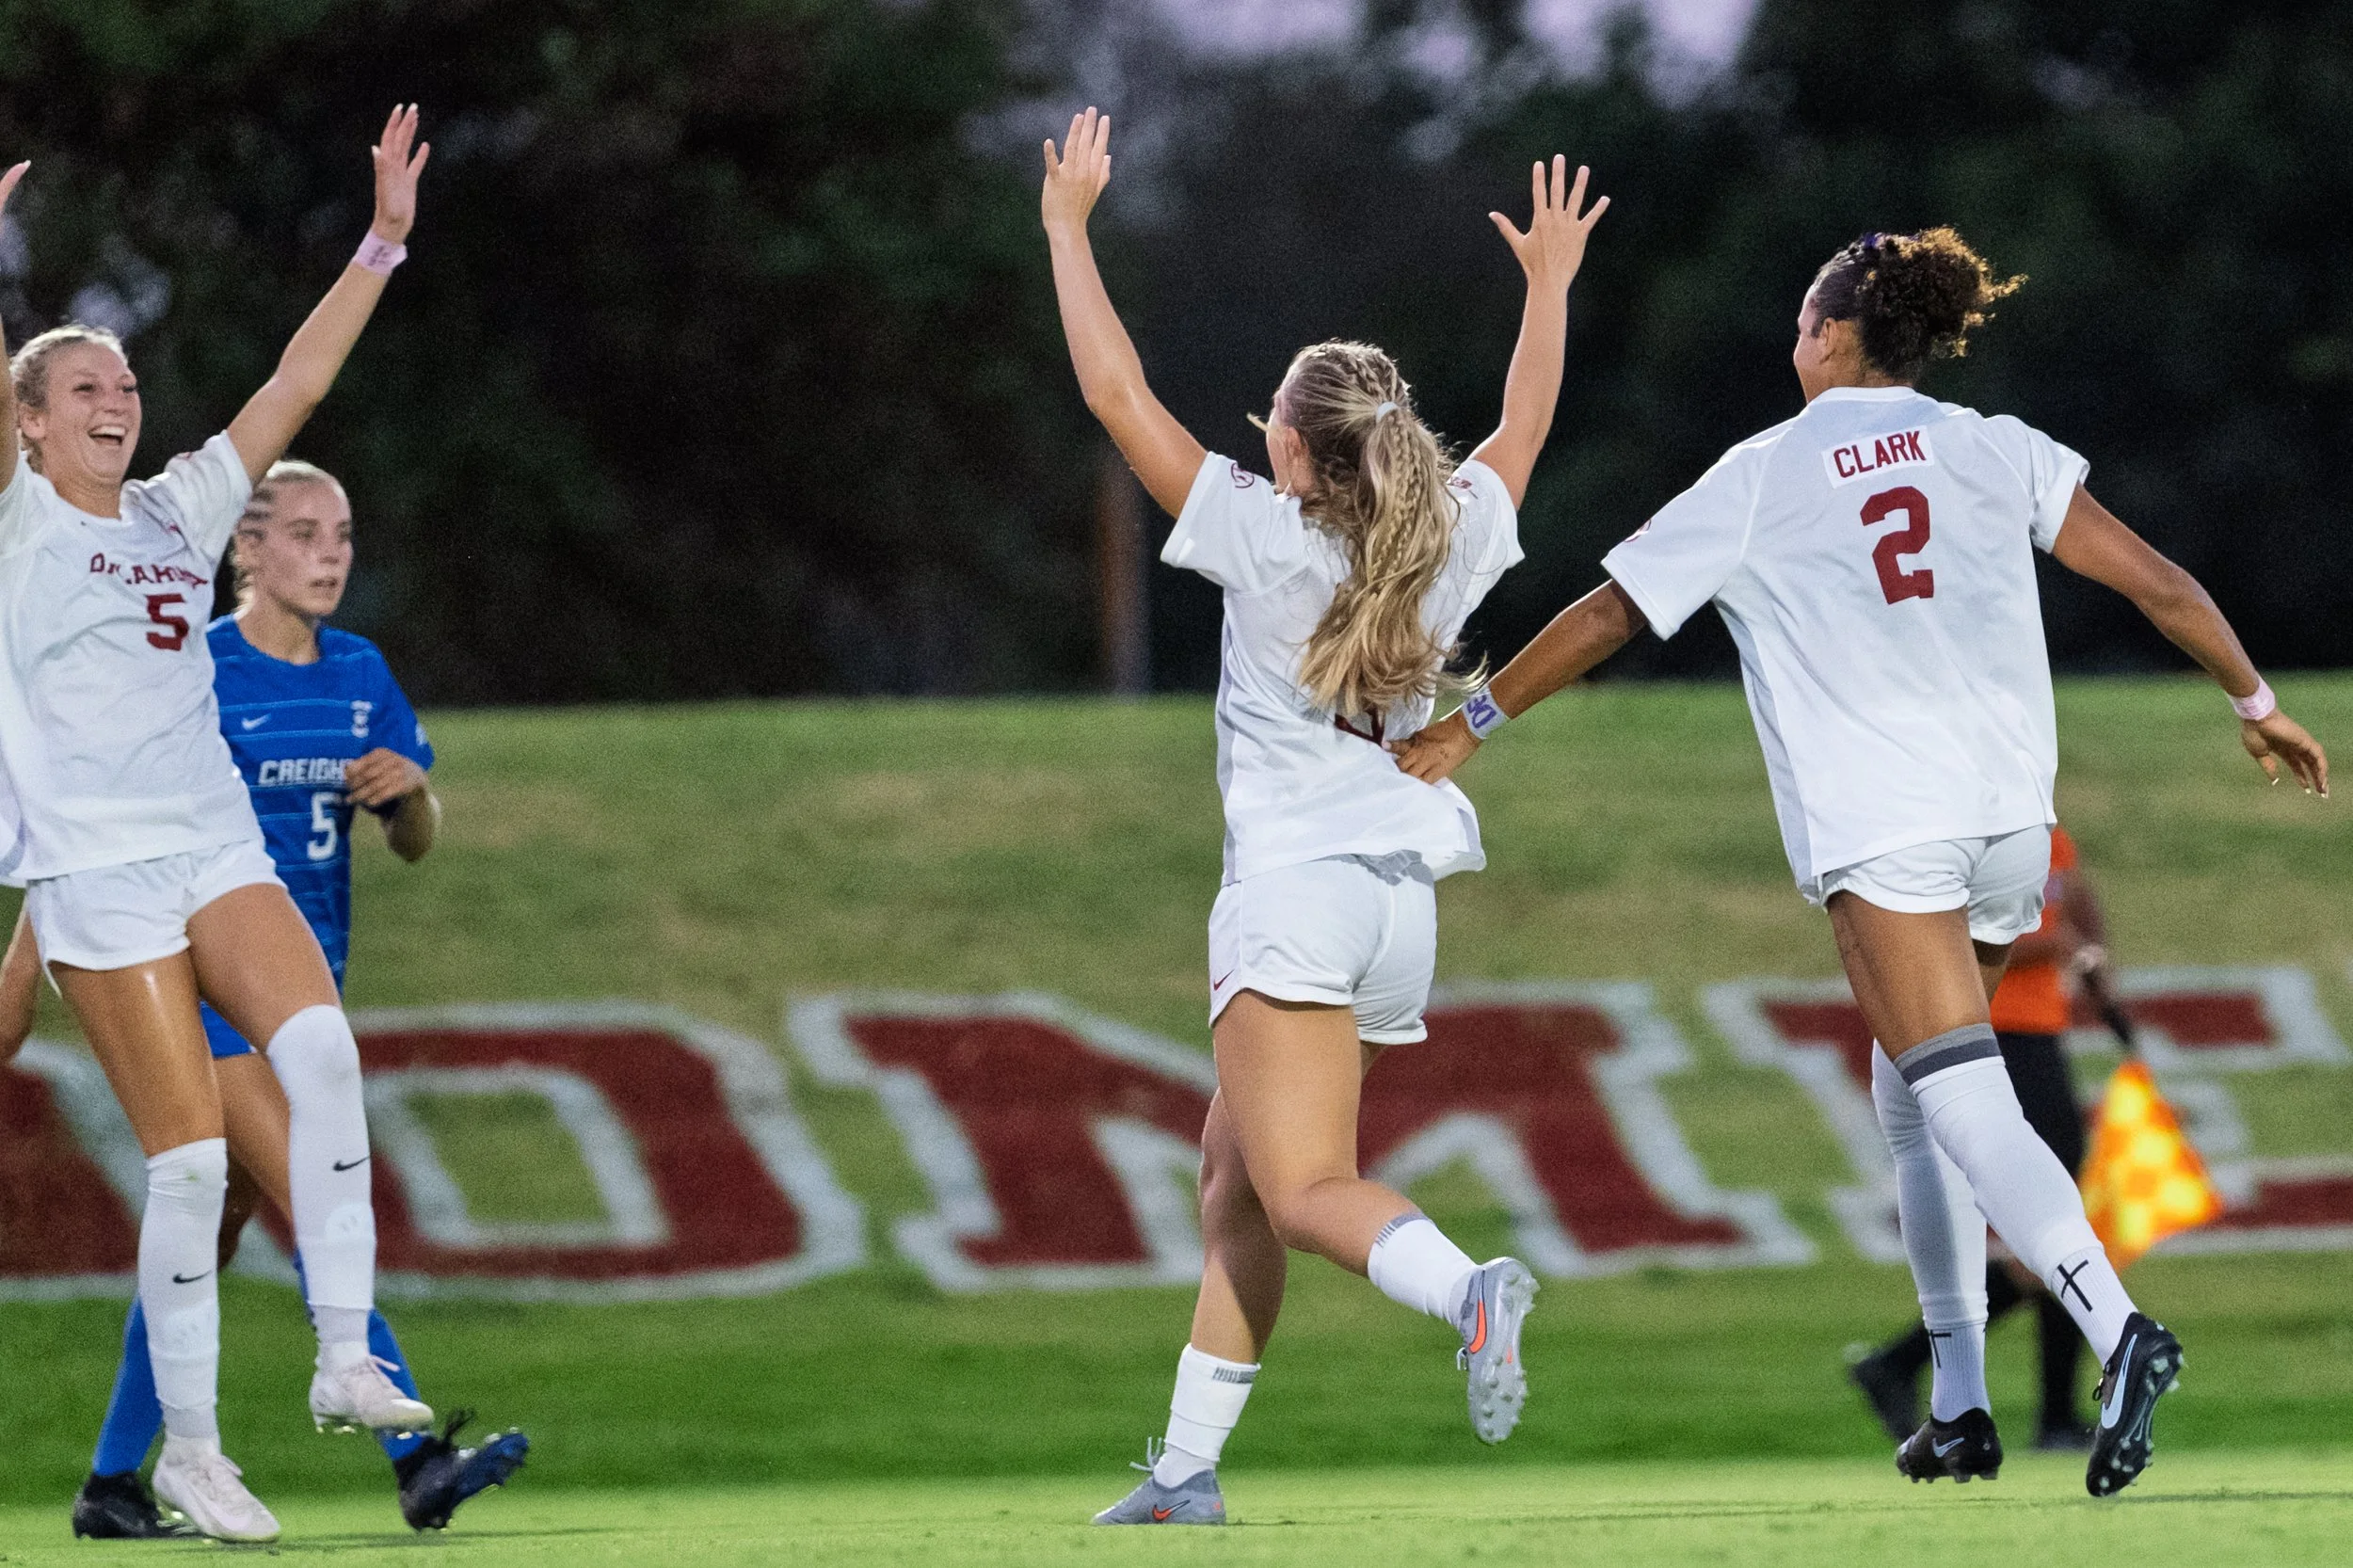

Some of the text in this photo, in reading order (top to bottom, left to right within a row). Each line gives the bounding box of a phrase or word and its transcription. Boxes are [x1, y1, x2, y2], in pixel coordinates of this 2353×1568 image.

[1833, 430, 1927, 478] CLARK
[1860, 486, 1934, 605] 2
[145, 593, 190, 651] 5
[307, 792, 343, 860] 5
